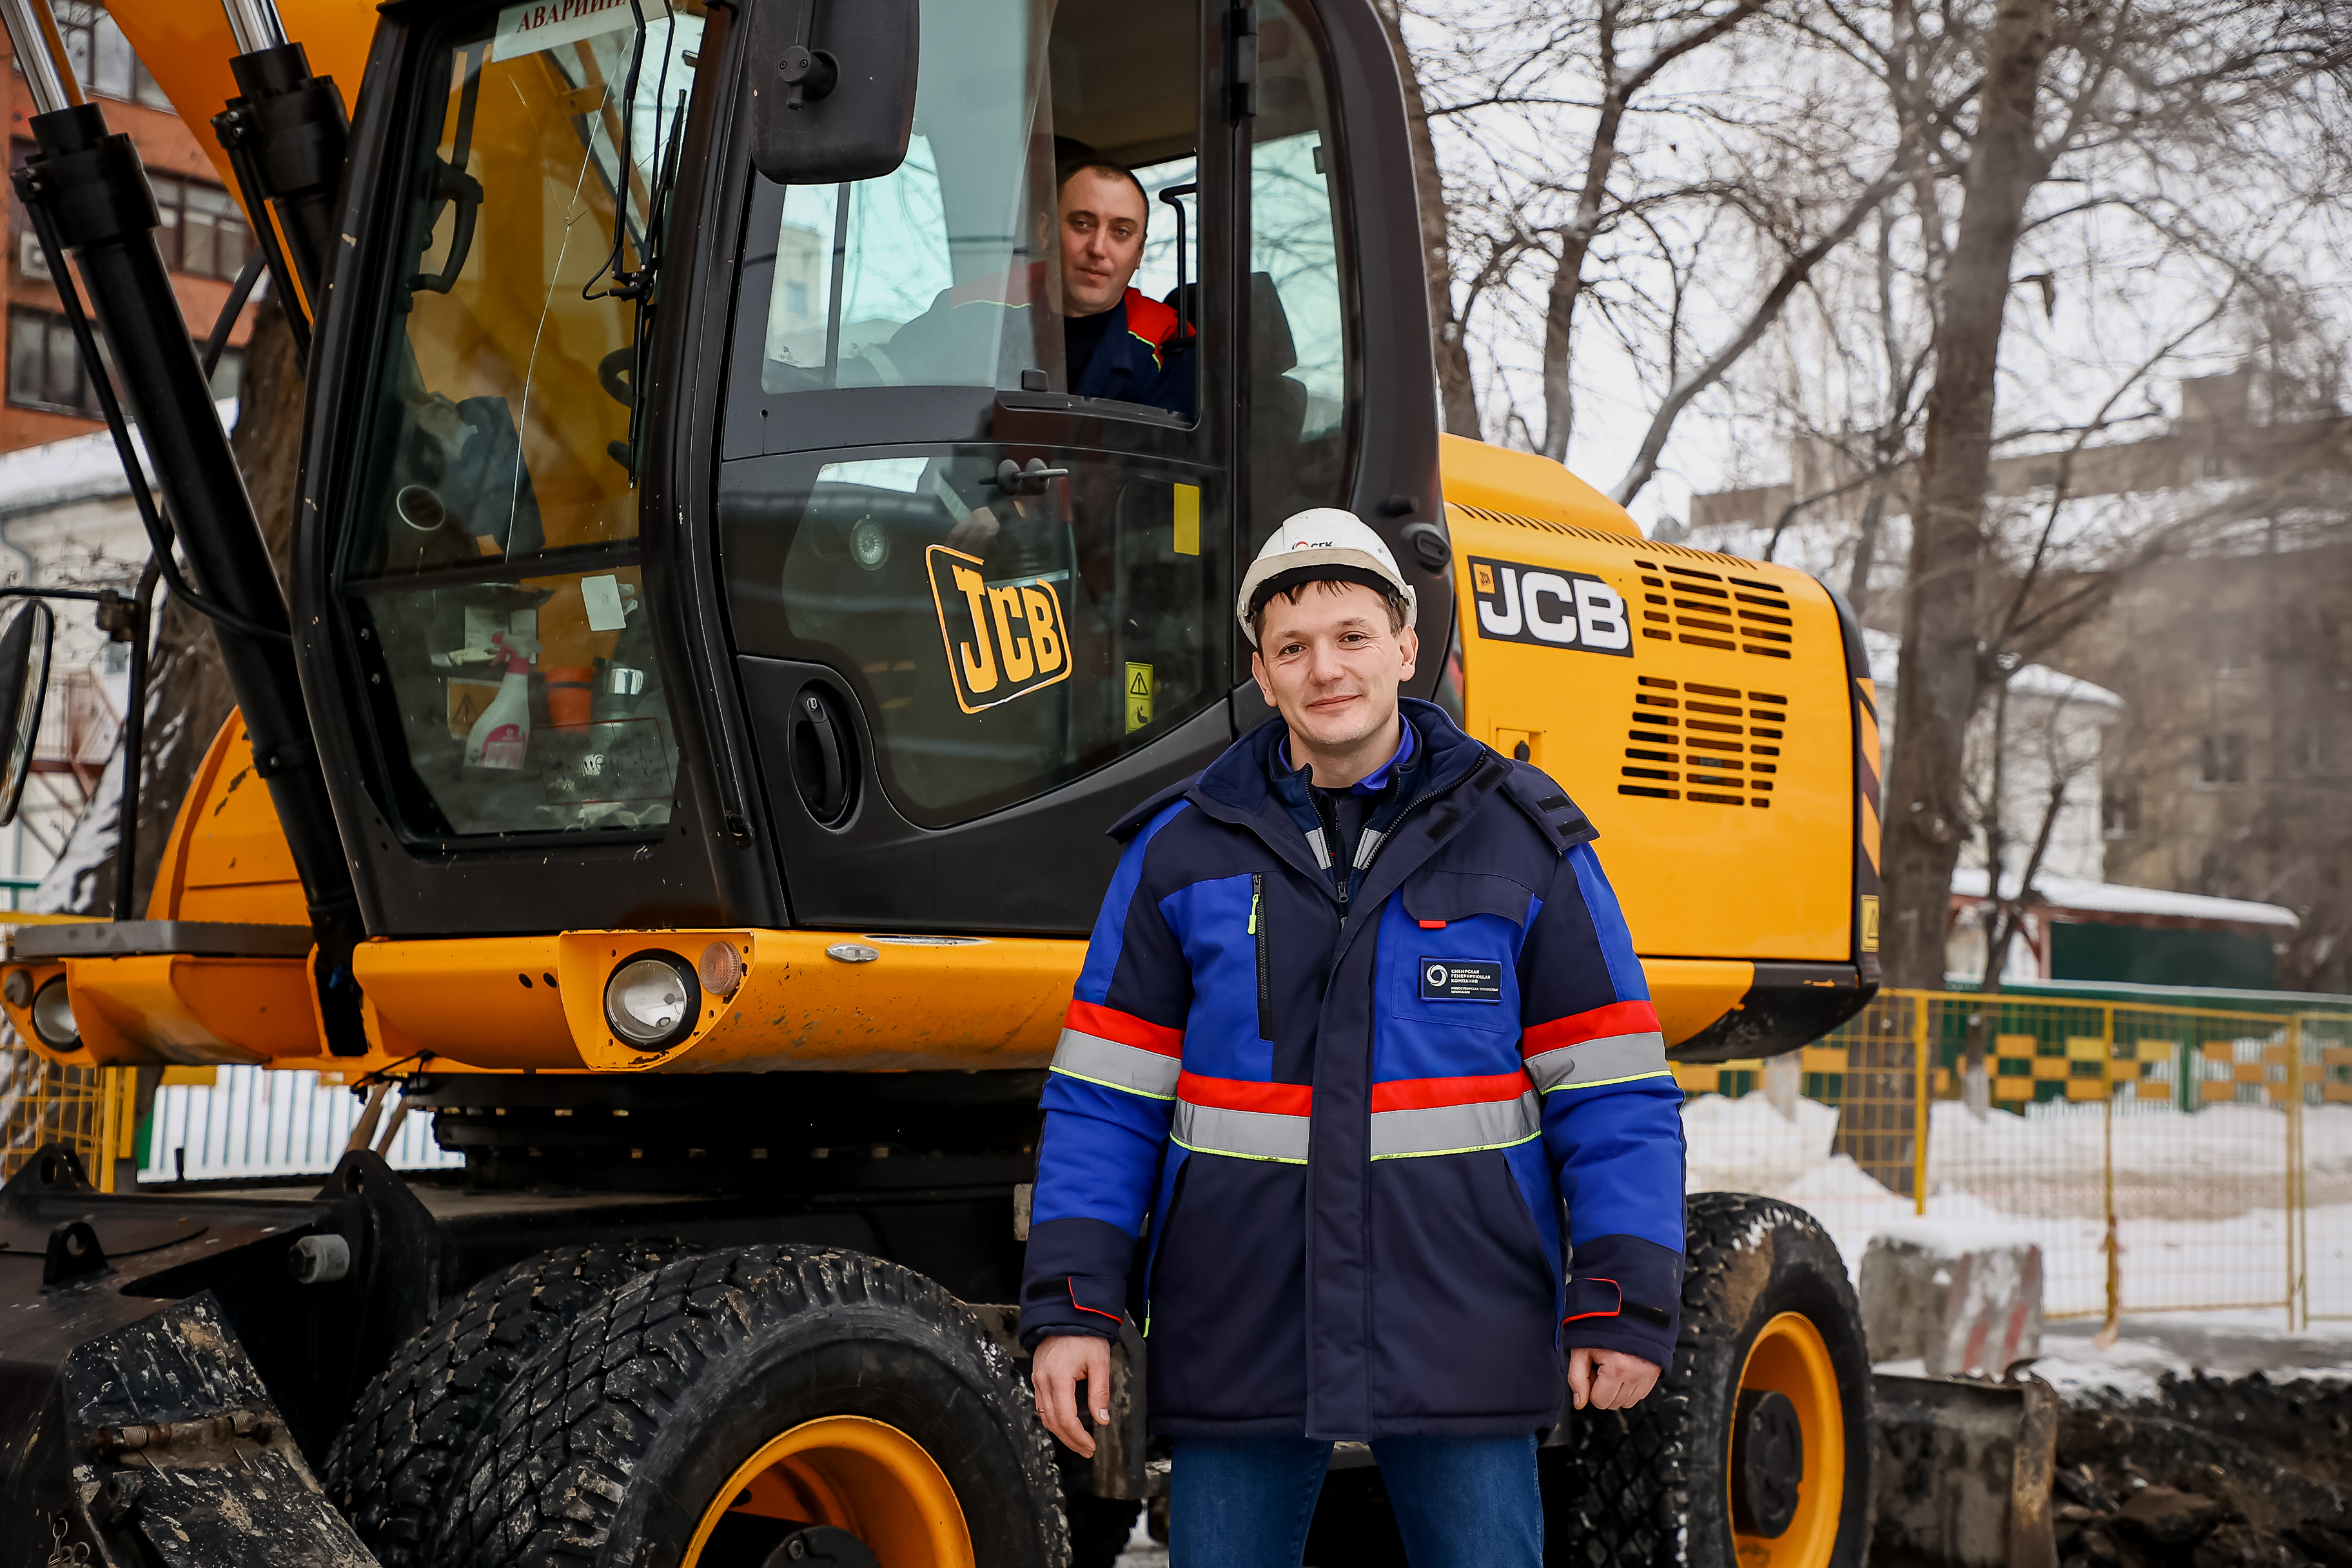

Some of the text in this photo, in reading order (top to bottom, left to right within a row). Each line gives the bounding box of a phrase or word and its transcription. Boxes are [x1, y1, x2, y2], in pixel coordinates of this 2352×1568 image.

[516, 0, 626, 33] АВАРИ
[952, 564, 1062, 693] JCB
[1478, 567, 1629, 650] JCB
